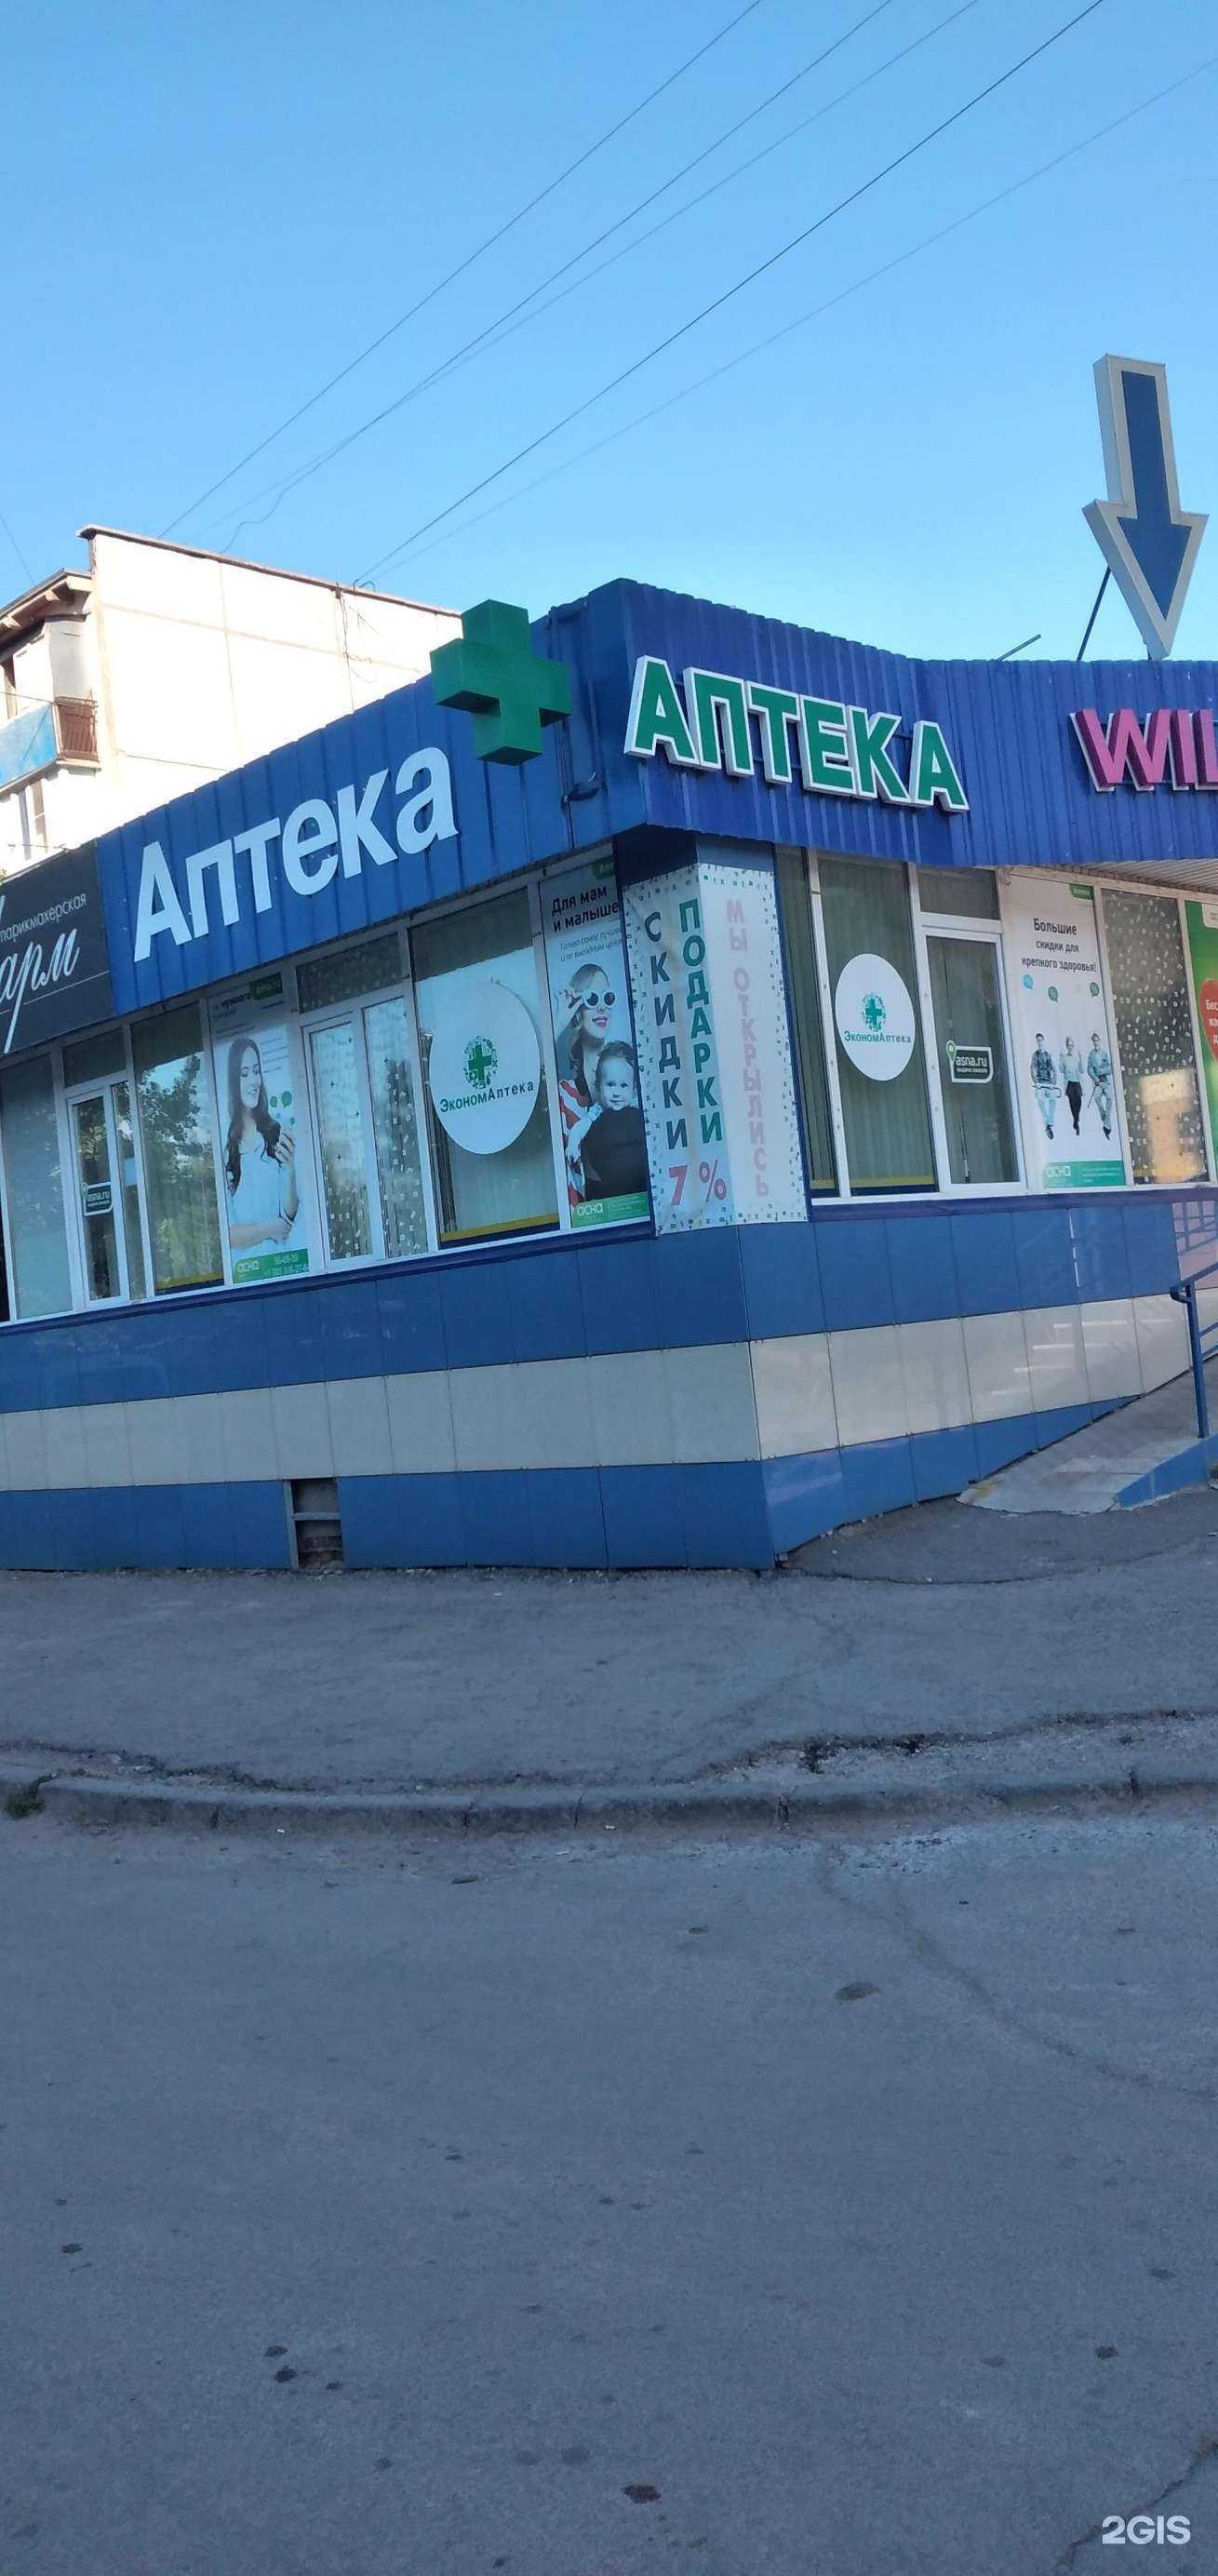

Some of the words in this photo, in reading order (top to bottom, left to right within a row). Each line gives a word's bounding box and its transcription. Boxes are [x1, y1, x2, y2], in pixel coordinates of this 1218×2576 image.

[623, 655, 970, 812] АПТЕКА
[134, 747, 460, 962] Аптека
[552, 896, 576, 917] Для
[580, 885, 608, 905] мам
[553, 919, 561, 932] и
[565, 902, 619, 927] малыше
[0, 893, 87, 943] парикмахерская
[1033, 918, 1077, 935] Большие
[1022, 957, 1058, 969] крепкого
[1036, 940, 1064, 952] скидки
[1065, 944, 1079, 953] для
[0, 928, 80, 1053] арм
[644, 911, 688, 1150] СКИДКИ
[679, 899, 723, 1144] ПОДАРКИ
[844, 1029, 912, 1043] ЭкономАптека
[956, 1056, 987, 1067] asna.ru
[439, 1080, 535, 1113] ЭкономАптека
[668, 1164, 689, 1207] 7
[698, 1160, 728, 1203] %
